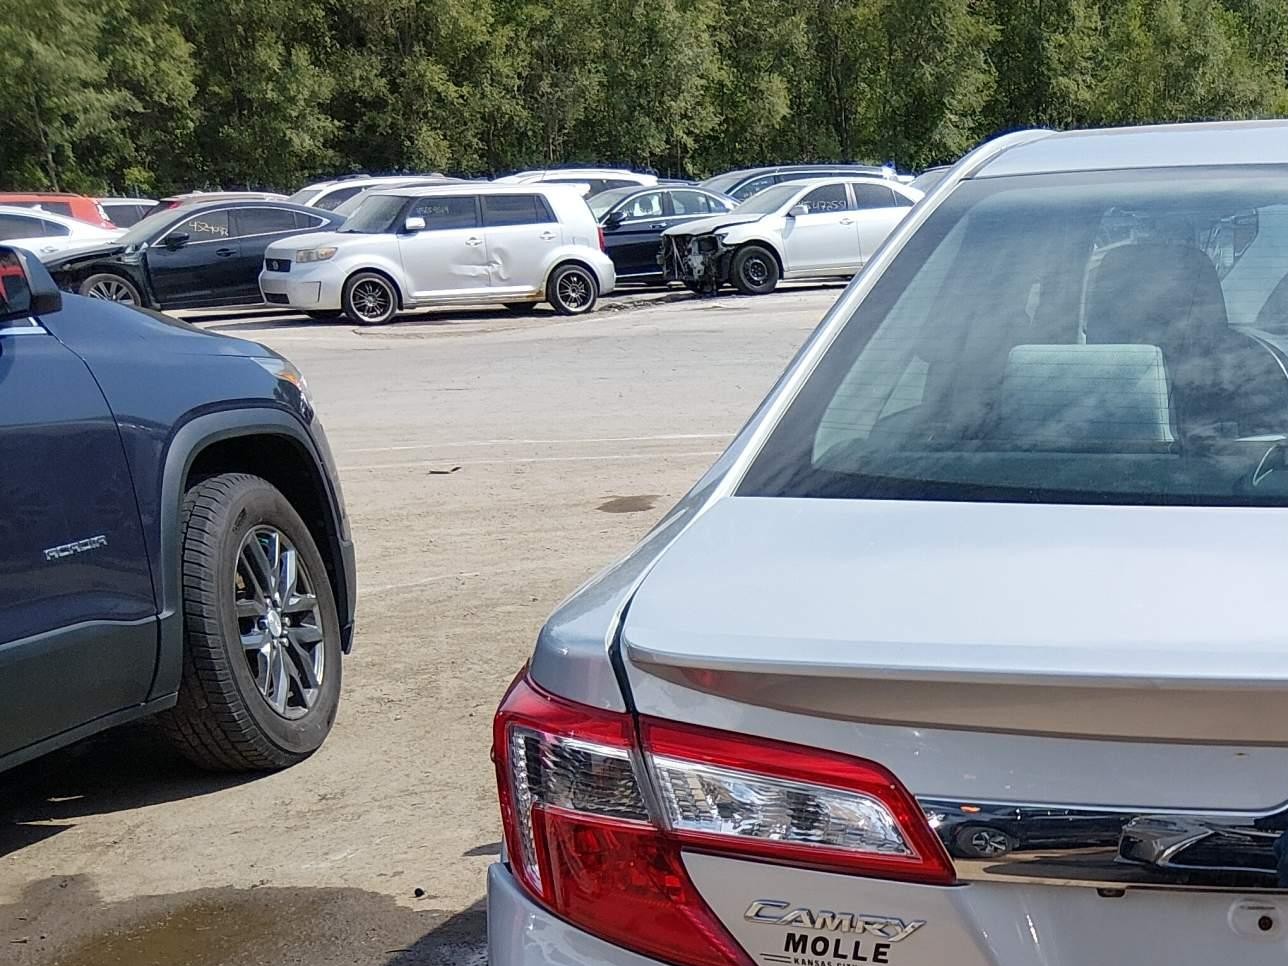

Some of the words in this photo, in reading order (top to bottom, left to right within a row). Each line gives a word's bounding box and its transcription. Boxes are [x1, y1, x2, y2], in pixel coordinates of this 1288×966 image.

[44, 535, 108, 560] ACADIA
[744, 898, 927, 943] CAMRY
[784, 932, 891, 963] MOLLE
